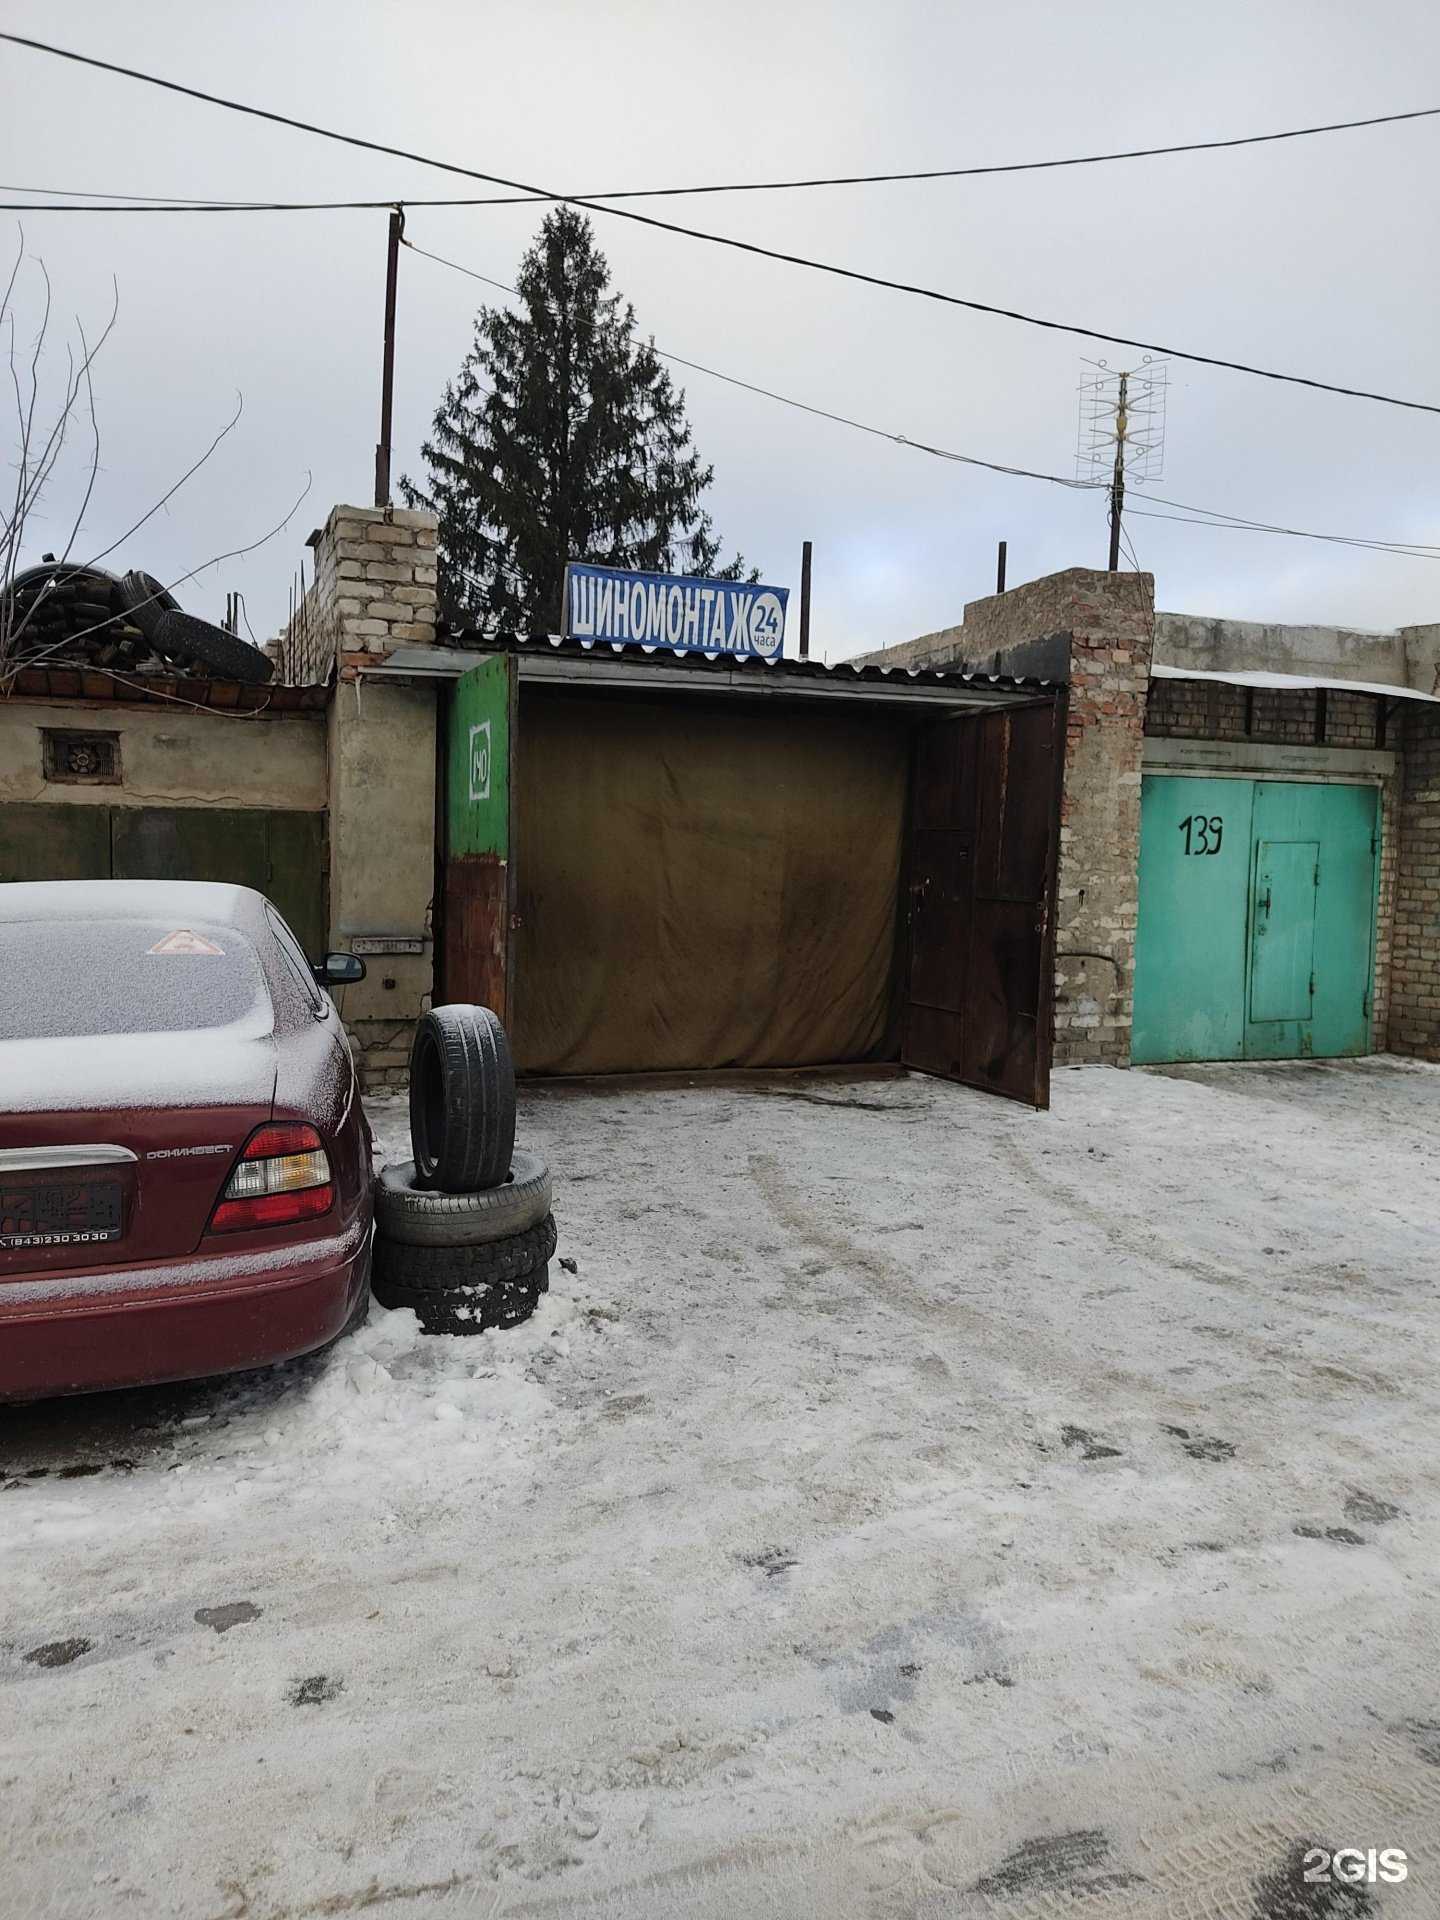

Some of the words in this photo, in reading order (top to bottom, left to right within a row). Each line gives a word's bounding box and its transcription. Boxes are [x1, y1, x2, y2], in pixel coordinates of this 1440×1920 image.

[572, 575, 753, 650] ШИНОМОНТАЖ
[755, 605, 778, 634] 24
[754, 635, 776, 647] часа
[1178, 815, 1223, 856] 139
